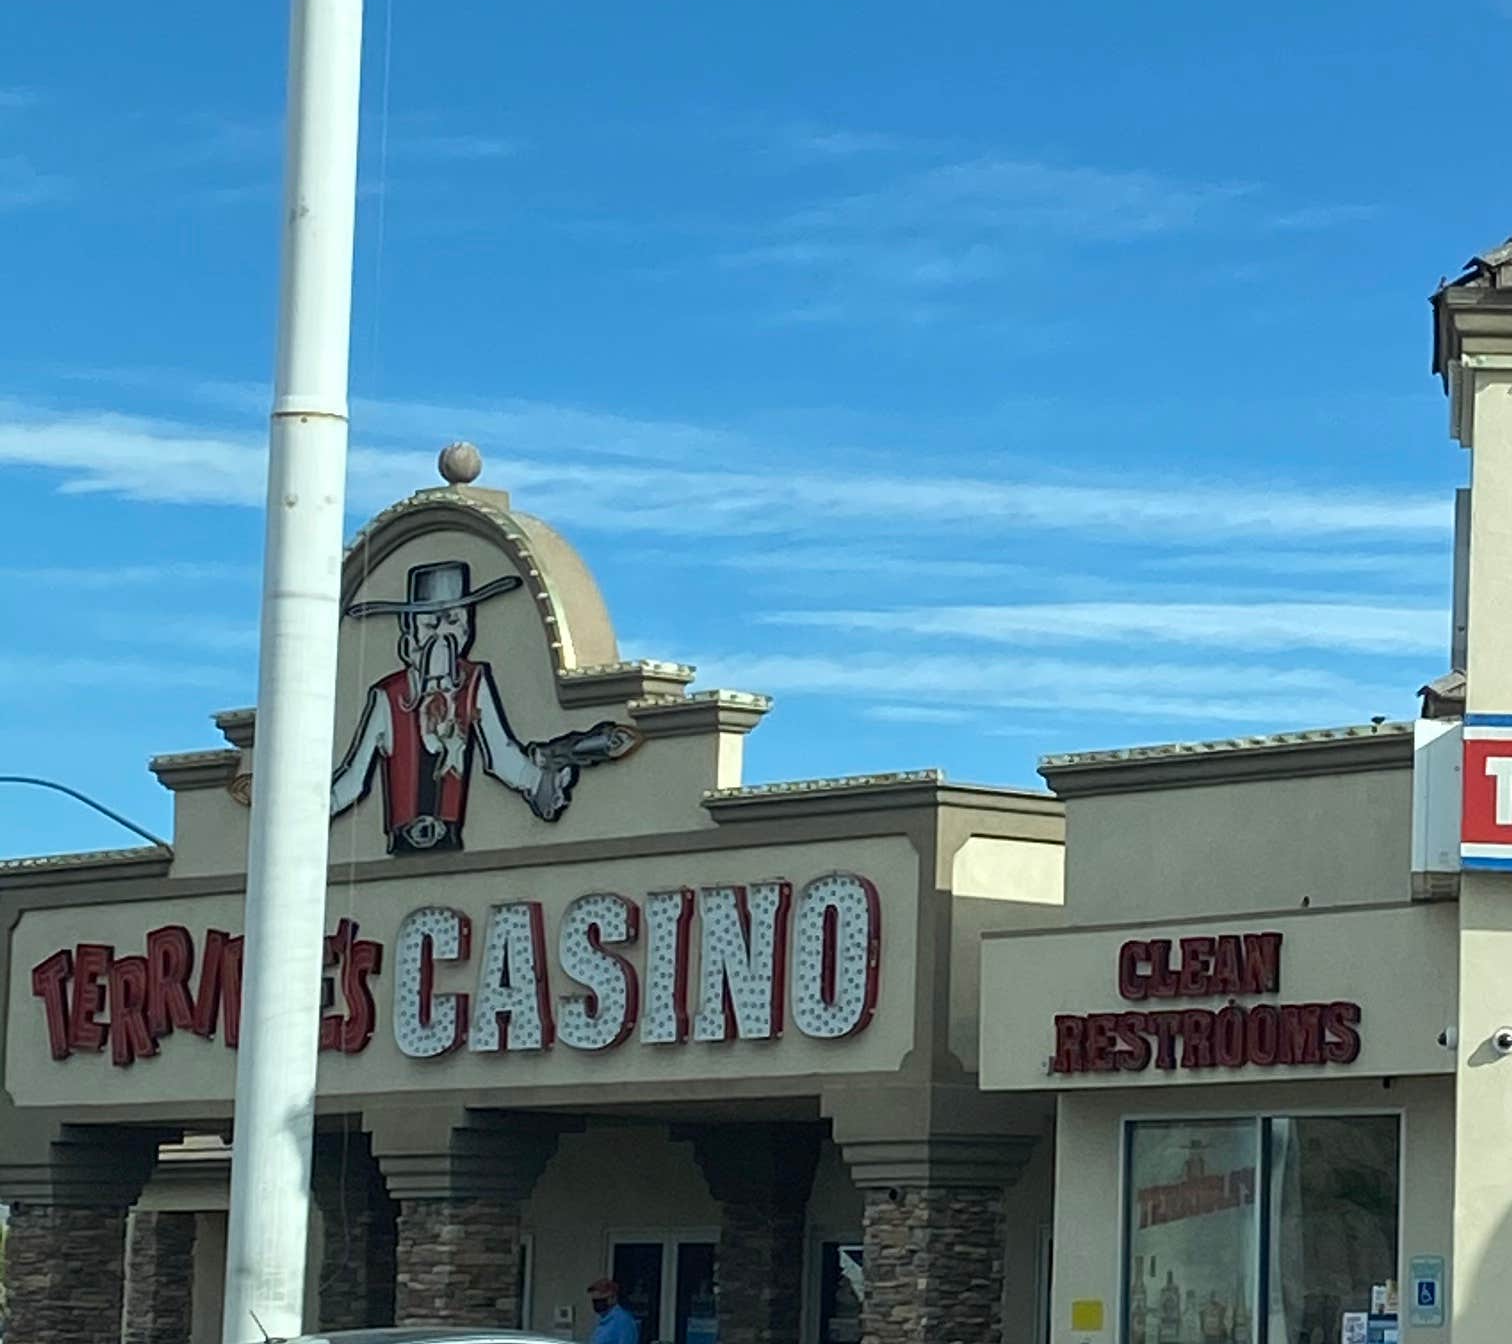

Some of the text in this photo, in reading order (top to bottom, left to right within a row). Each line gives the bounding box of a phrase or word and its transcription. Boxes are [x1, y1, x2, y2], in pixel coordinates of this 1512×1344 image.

[32, 872, 882, 1067] TERRI'S CASINO
[1119, 931, 1283, 1000] CLEAN
[1053, 1001, 1361, 1073] RESTROOMS
